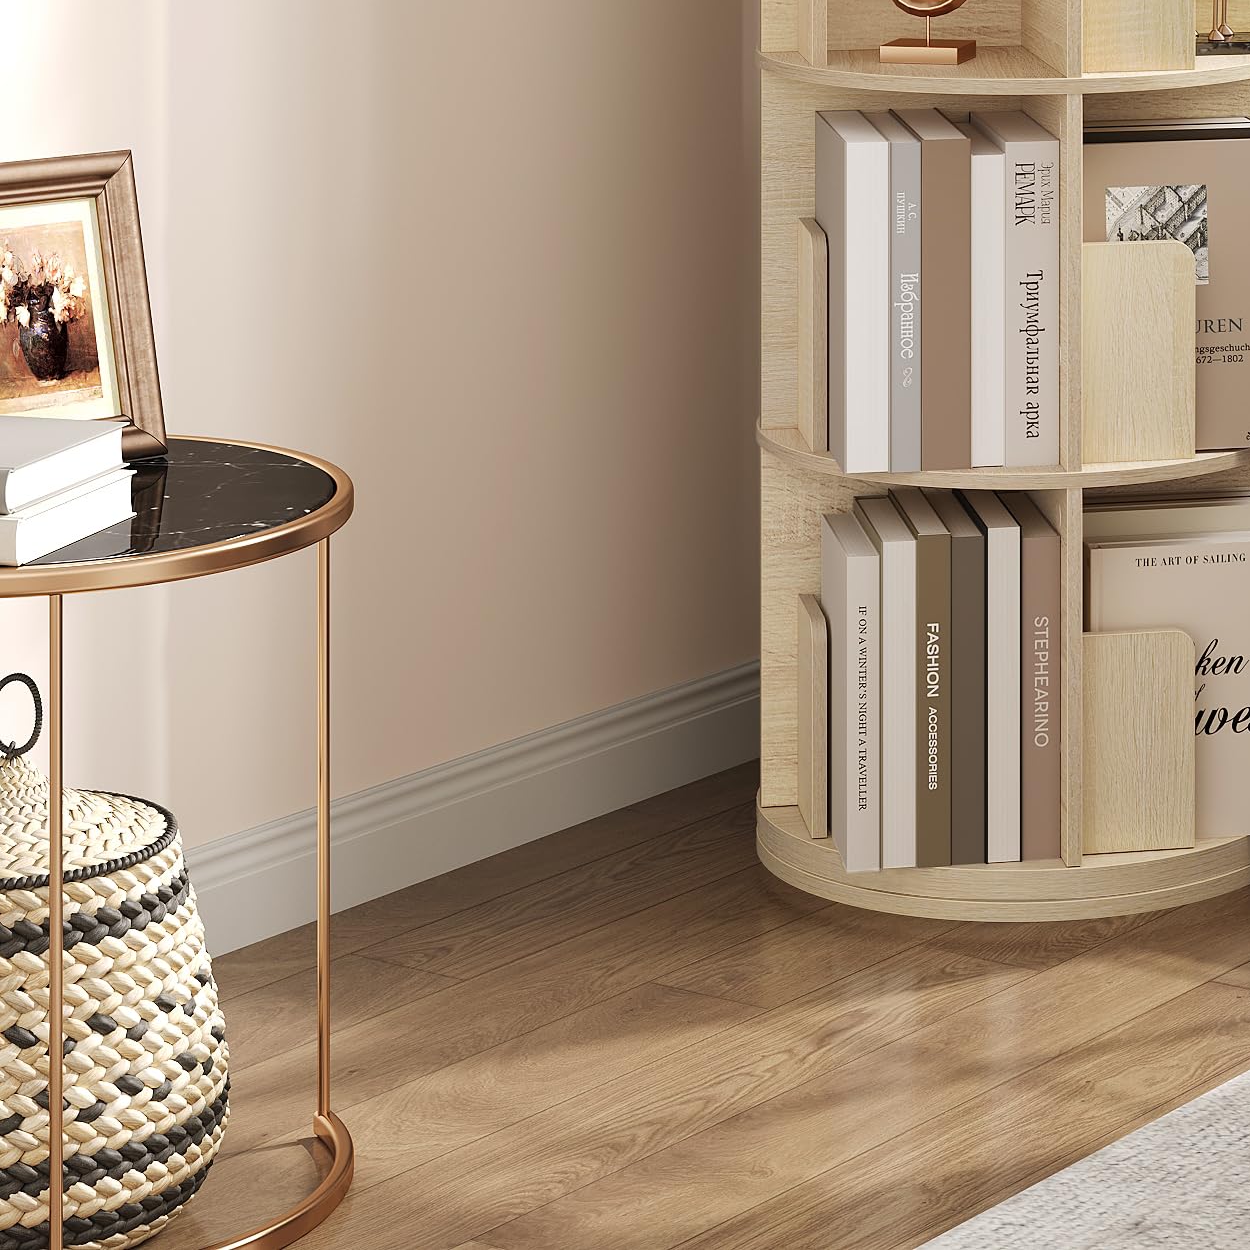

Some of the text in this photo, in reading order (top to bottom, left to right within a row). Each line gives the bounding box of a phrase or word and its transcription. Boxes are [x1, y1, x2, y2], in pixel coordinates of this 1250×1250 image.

[896, 192, 906, 234] ПУШКИН
[1014, 161, 1036, 226] РЕМАРК
[1037, 161, 1054, 225] Эрих Мария
[894, 273, 920, 360] Избранное
[1019, 401, 1041, 439] арка
[1135, 552, 1247, 568] THE ART OF SAILING
[858, 605, 868, 616] IF
[858, 618, 868, 635] ON
[858, 637, 868, 645] A
[1034, 616, 1050, 748] STEPHEARINO
[858, 702, 868, 737] NIGHT
[926, 622, 940, 791] FASHION ACCESSORIES
[858, 738, 868, 747] A
[858, 748, 868, 812] TRAVELLER
